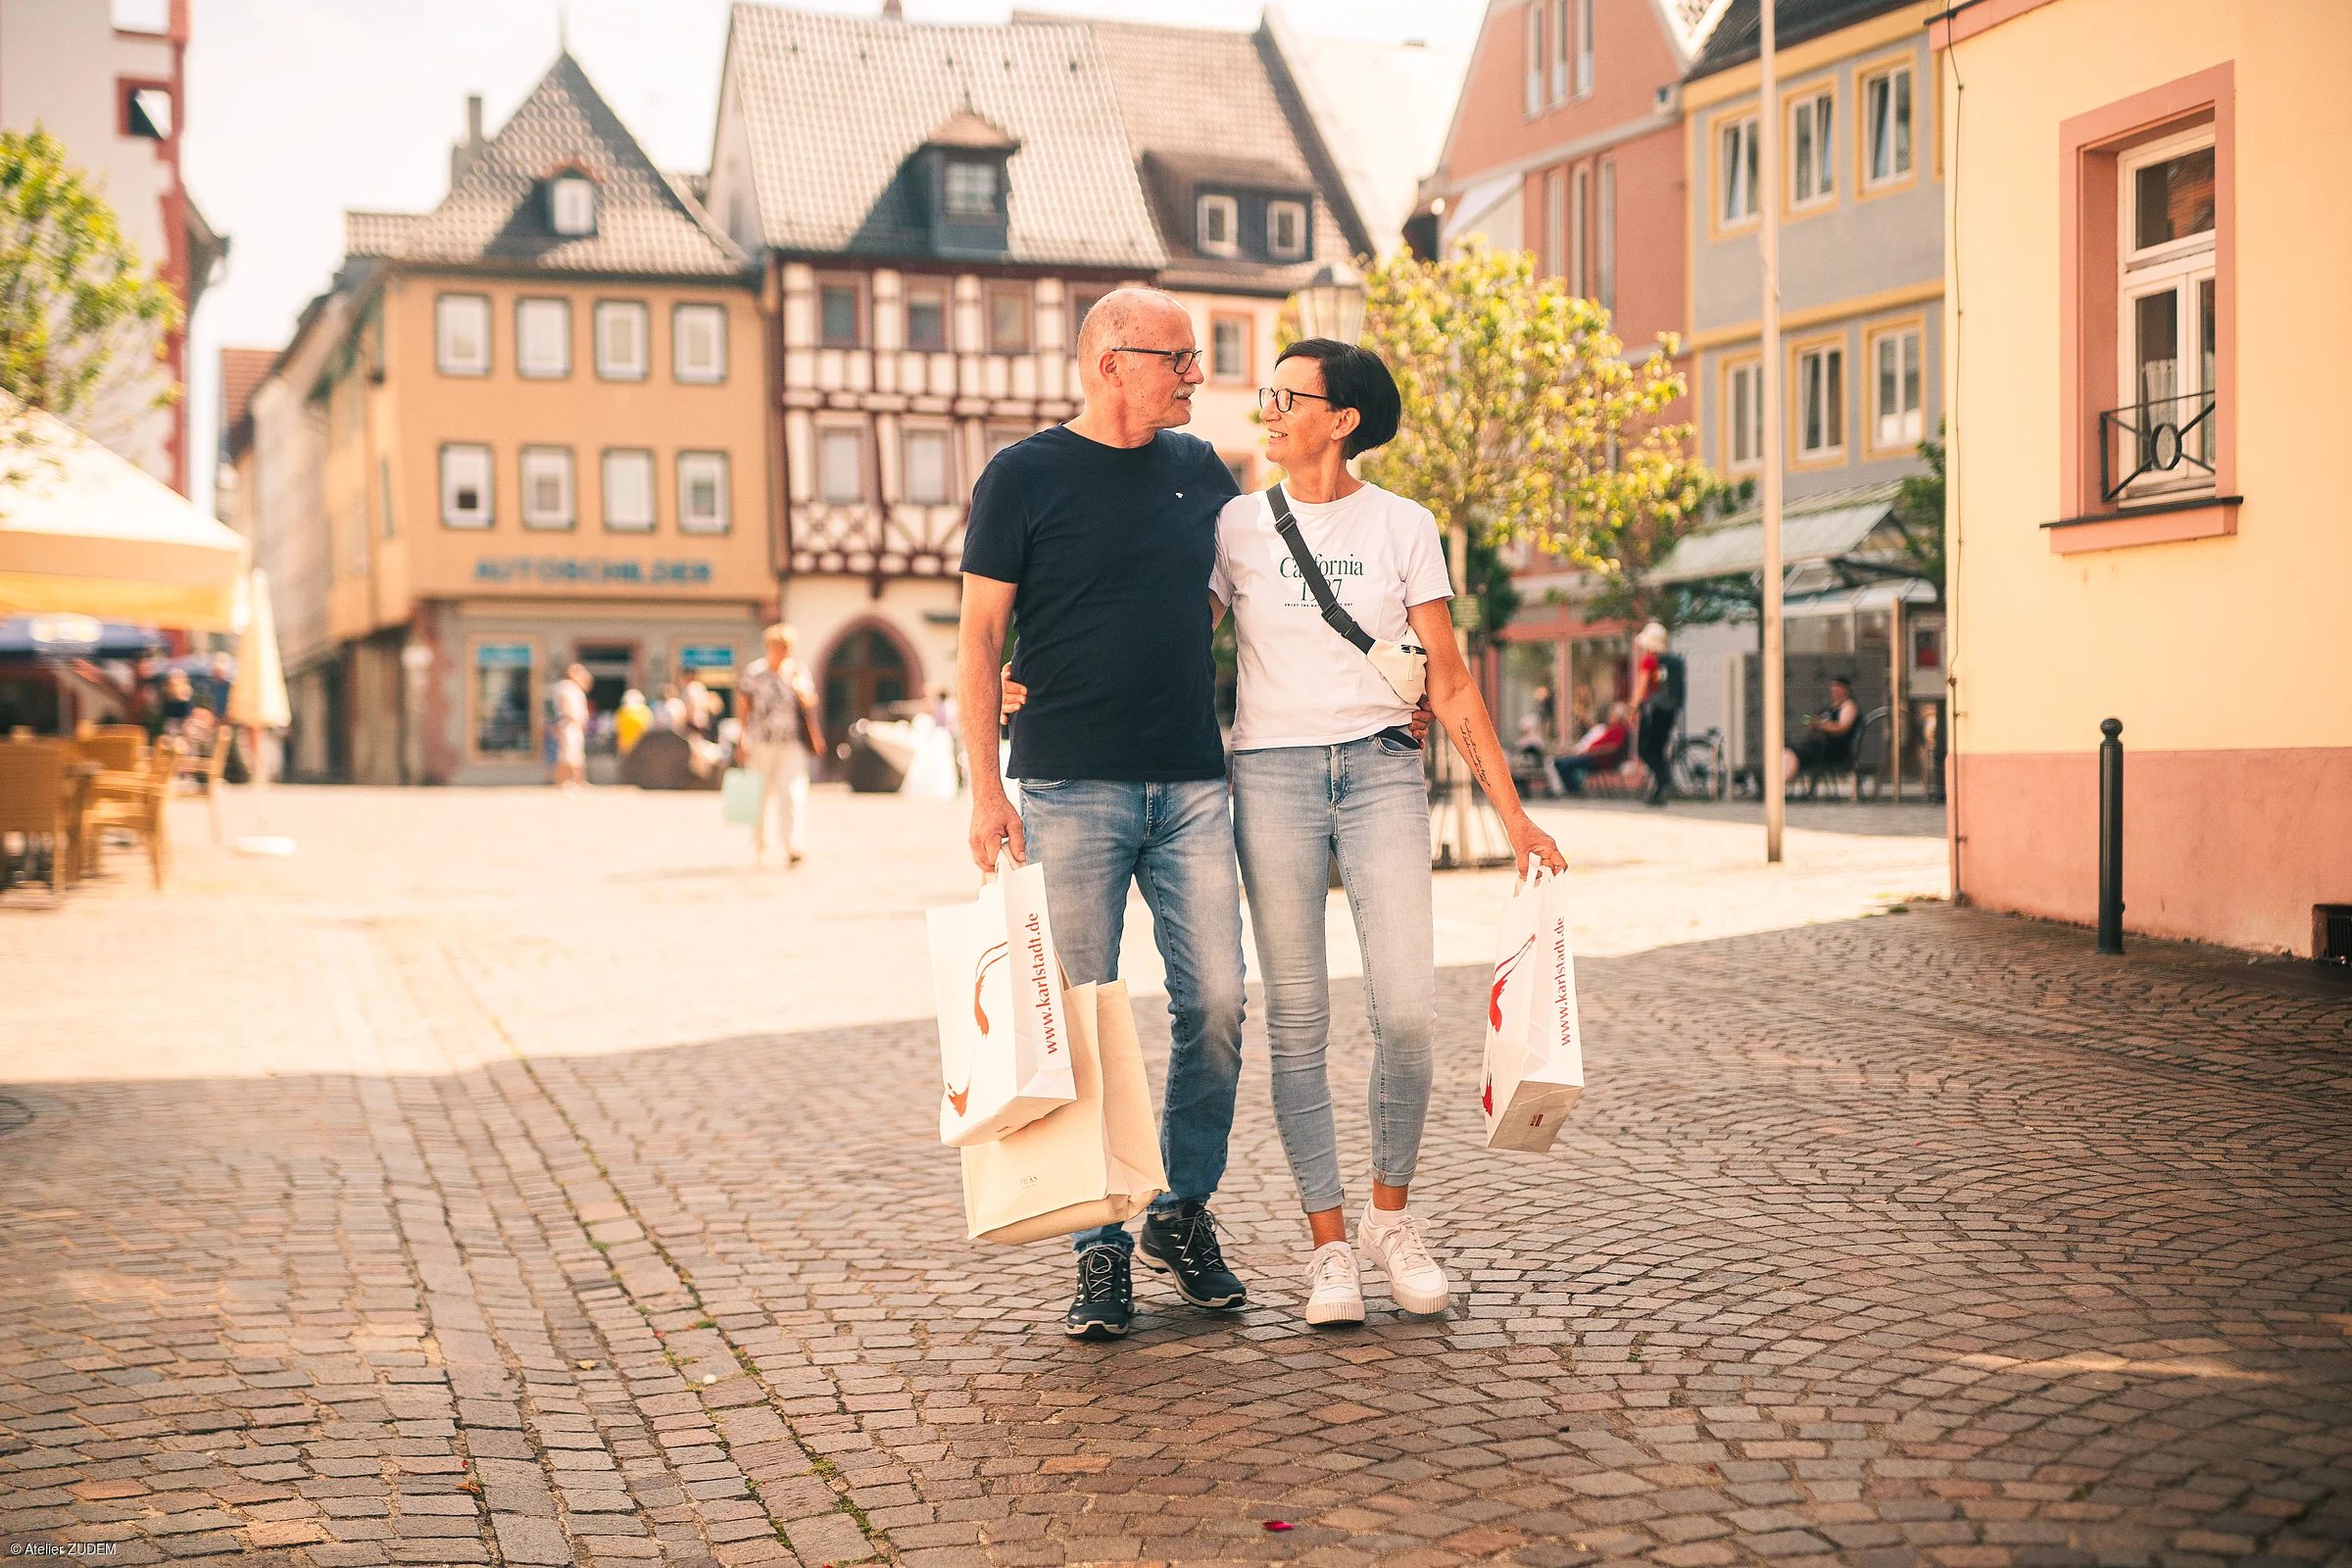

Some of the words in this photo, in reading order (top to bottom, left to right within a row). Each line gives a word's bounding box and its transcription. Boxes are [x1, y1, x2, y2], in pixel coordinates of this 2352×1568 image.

[1279, 553, 1364, 578] Cafornia
[1300, 578, 1343, 602] 17
[1025, 911, 1058, 1055] www.karlstadt.de
[1553, 916, 1571, 1047] www.karlstadt.de
